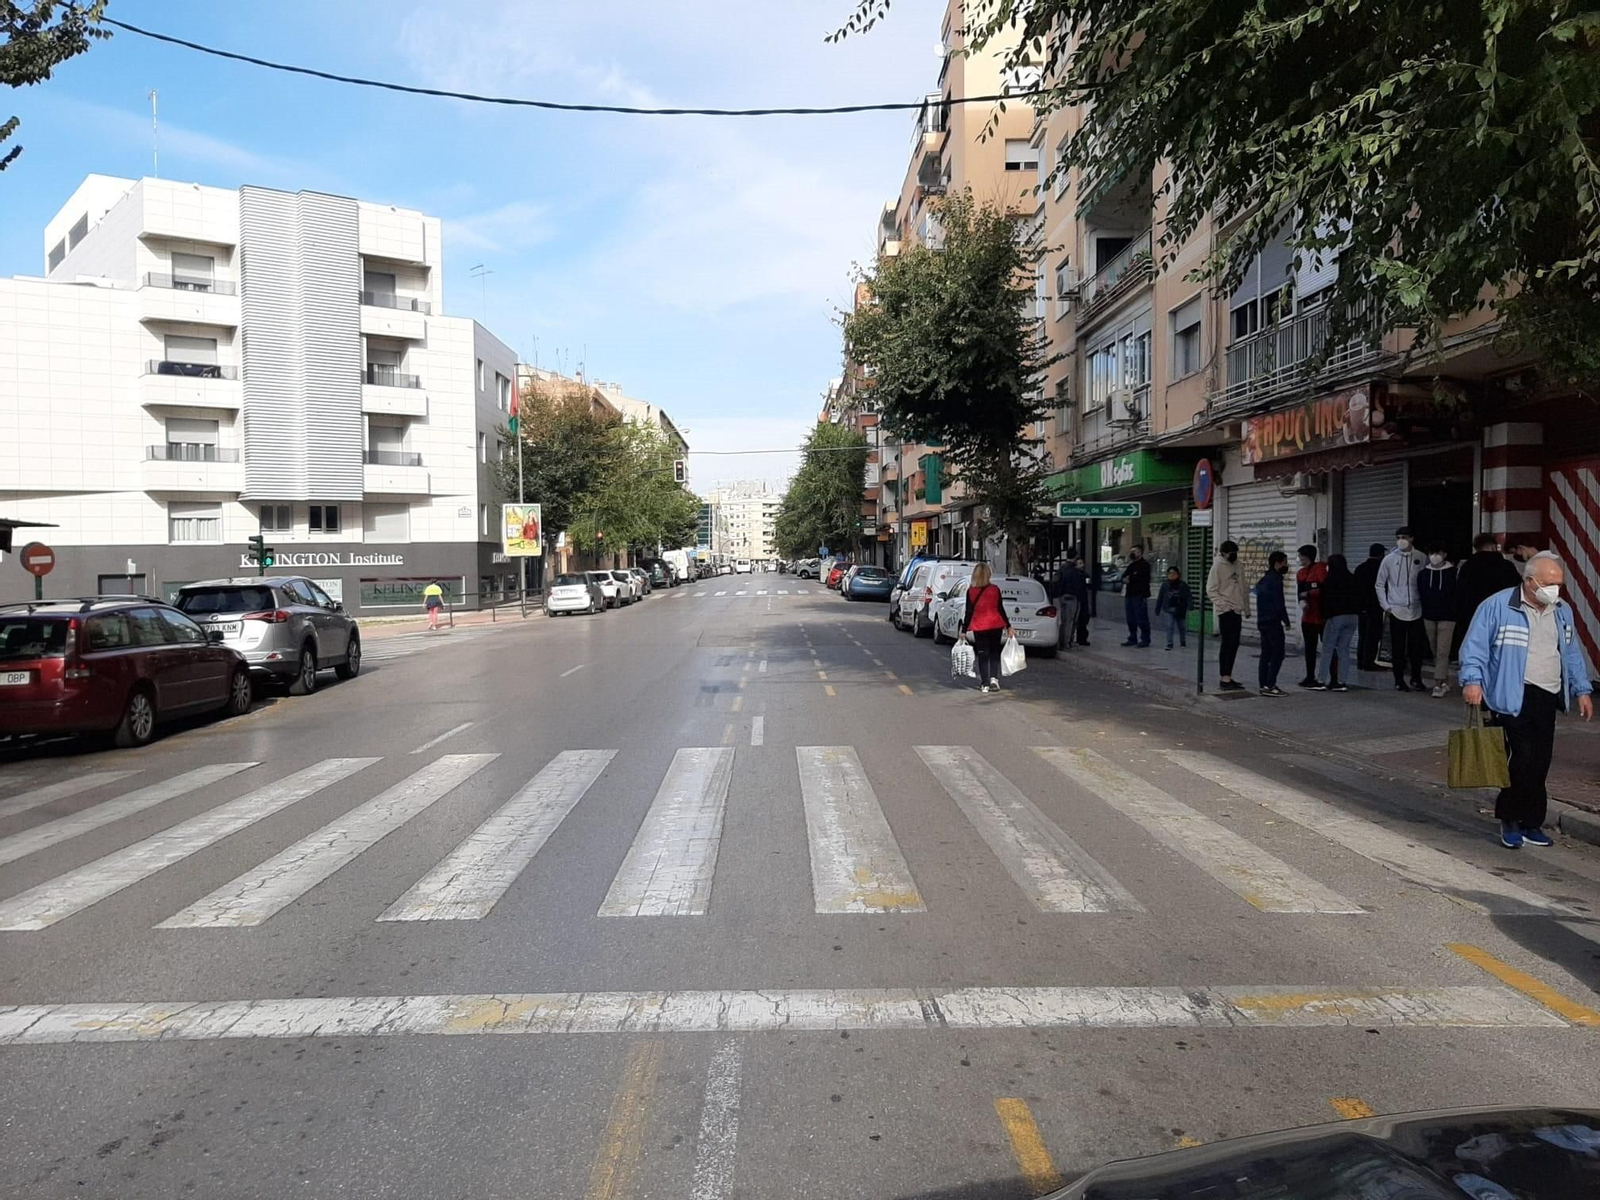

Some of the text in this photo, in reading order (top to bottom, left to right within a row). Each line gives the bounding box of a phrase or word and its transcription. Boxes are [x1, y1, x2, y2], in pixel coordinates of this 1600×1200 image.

[241, 552, 403, 566] KINGTON Institute
[374, 583, 451, 595] KELINGN
[222, 623, 237, 631] KNM
